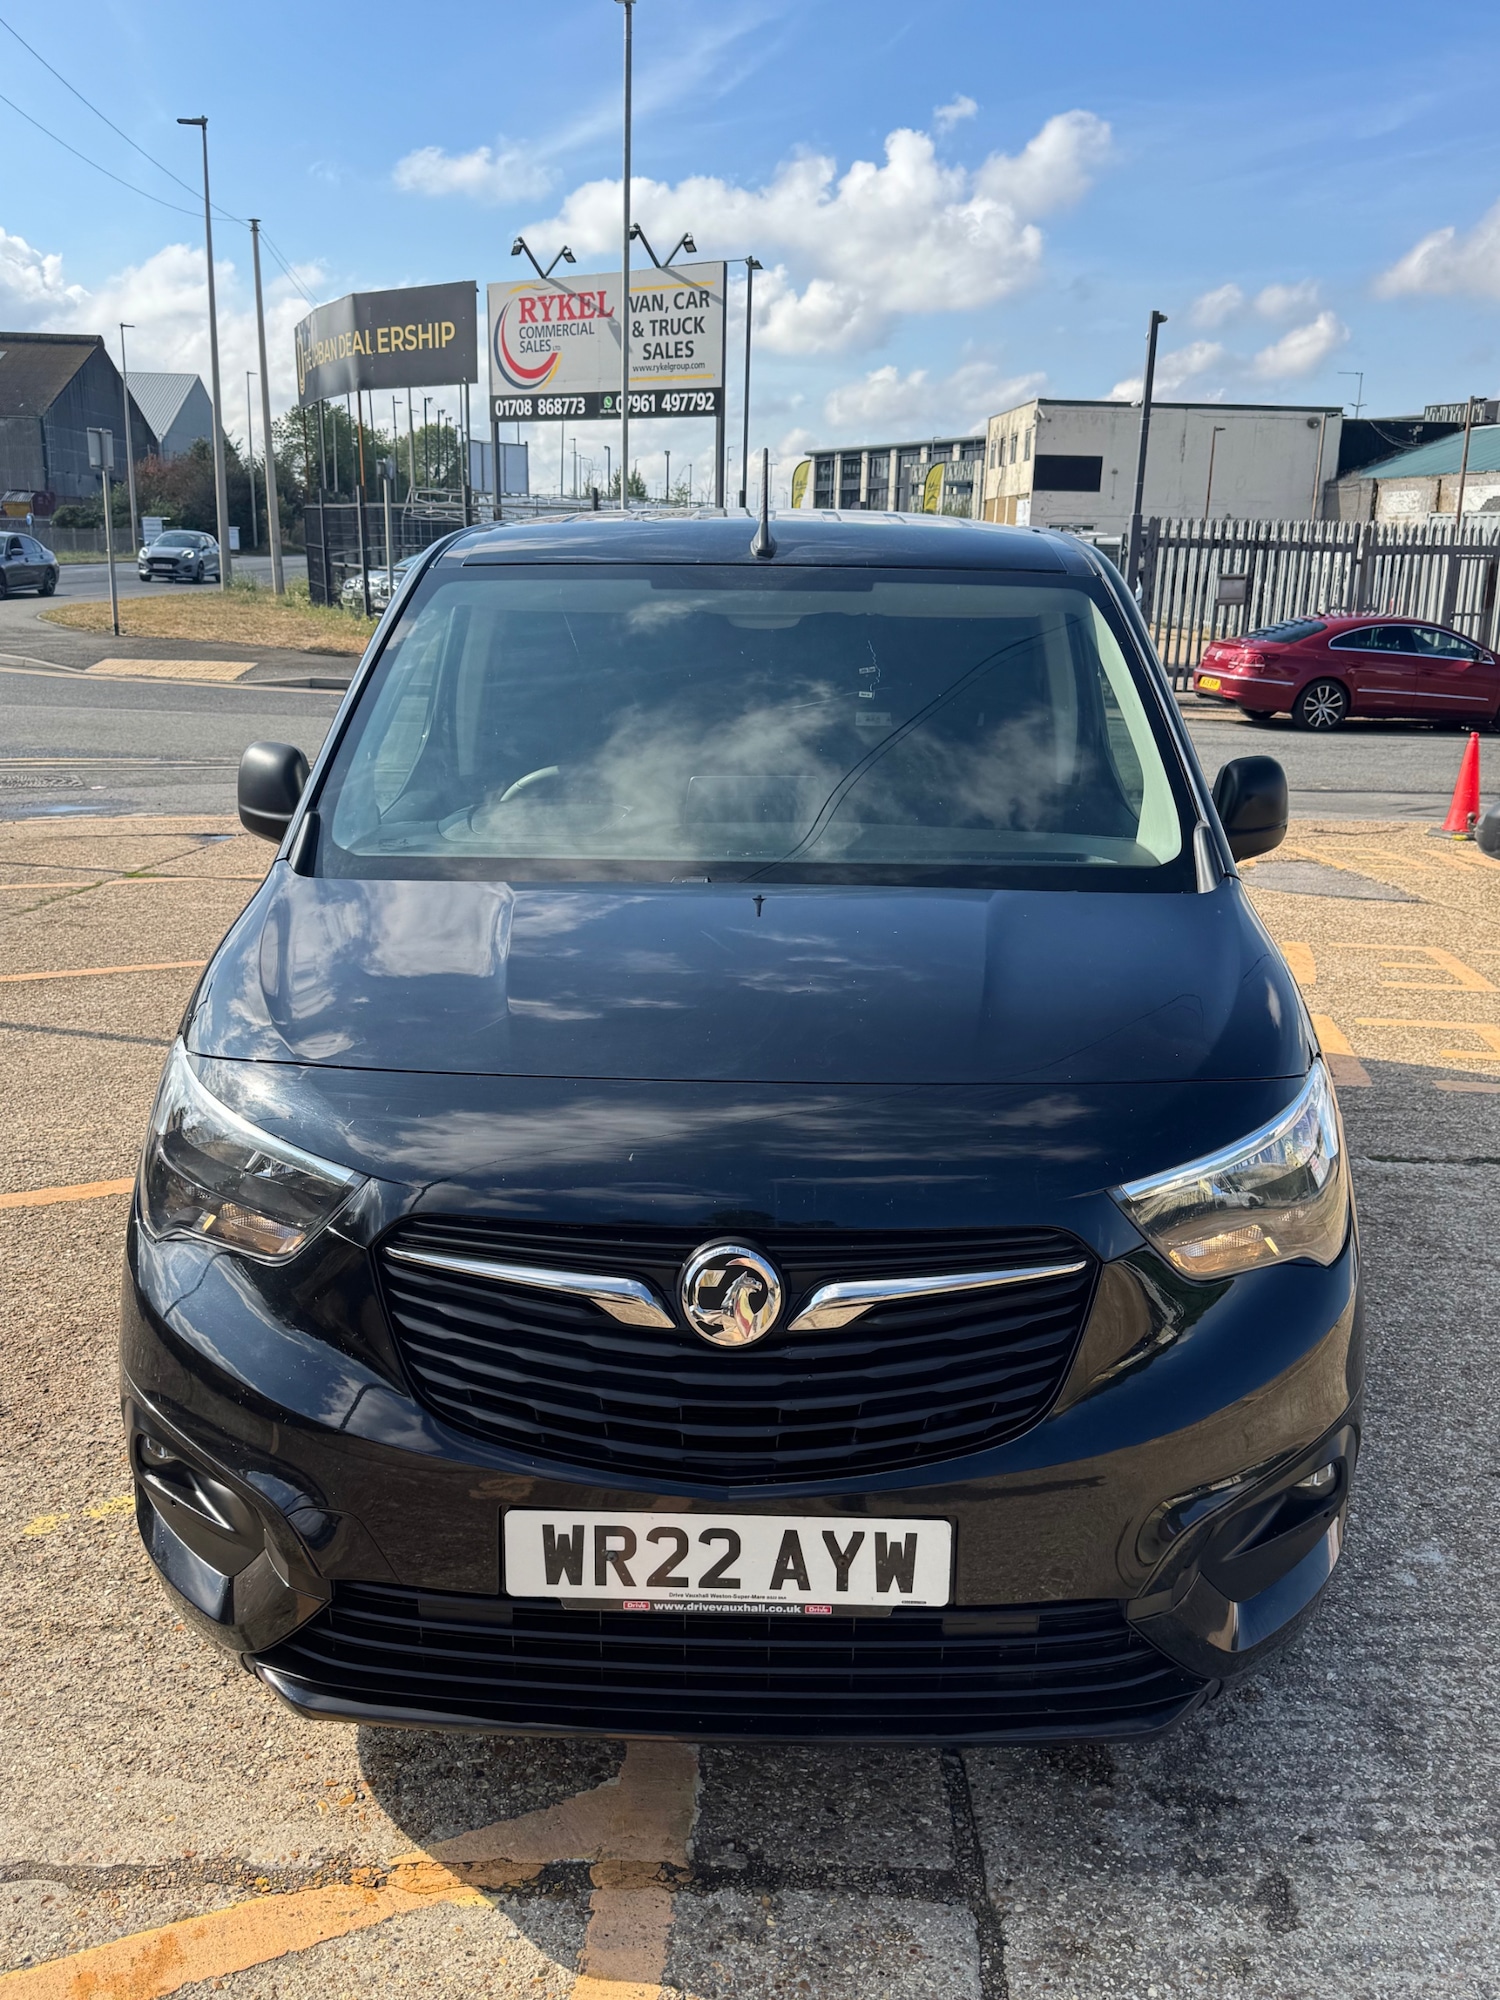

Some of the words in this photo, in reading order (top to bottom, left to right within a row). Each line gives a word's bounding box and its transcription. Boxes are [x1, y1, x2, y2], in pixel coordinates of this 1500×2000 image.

[518, 290, 615, 324] RYKEL
[628, 293, 669, 314] VAN,
[673, 290, 710, 310] CAR
[519, 321, 595, 340] COMMERCIAL
[632, 320, 645, 338] &
[649, 316, 706, 337] TRUCK
[311, 336, 338, 369] URBAN
[338, 321, 456, 359] DEALERSHIP
[519, 339, 552, 353] SALES
[642, 340, 694, 361] SALES
[632, 361, 706, 374] www.rykelgroup.com
[495, 399, 532, 416] 01708
[537, 397, 586, 415] 868773
[661, 392, 715, 412] 497792
[542, 1524, 741, 1589] WR22
[769, 1529, 918, 1593] AYW
[653, 1602, 802, 1614] www.drivevauxhall.co.uk
